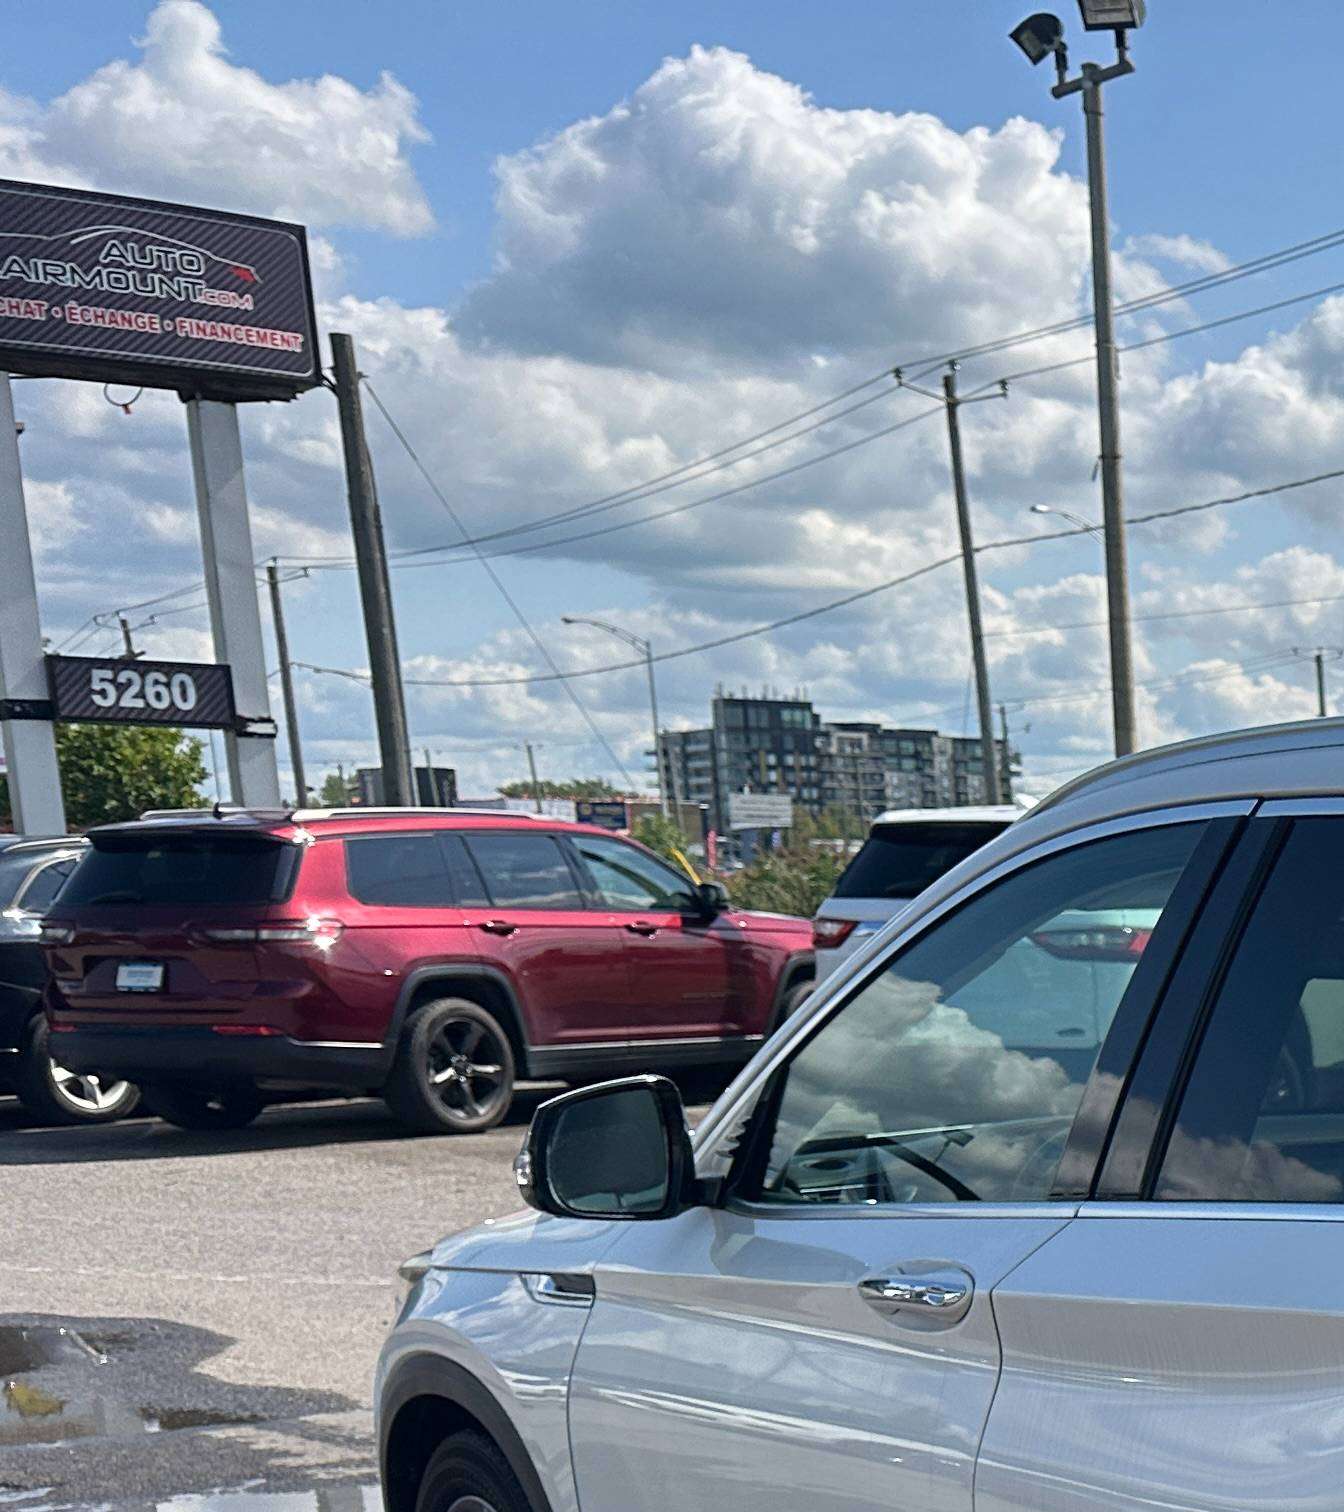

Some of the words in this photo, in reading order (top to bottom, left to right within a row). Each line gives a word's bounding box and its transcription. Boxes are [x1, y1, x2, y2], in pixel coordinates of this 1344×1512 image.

[99, 240, 205, 276] AUTO
[175, 317, 304, 352] FINANCEMENT
[90, 668, 198, 711] 5260
